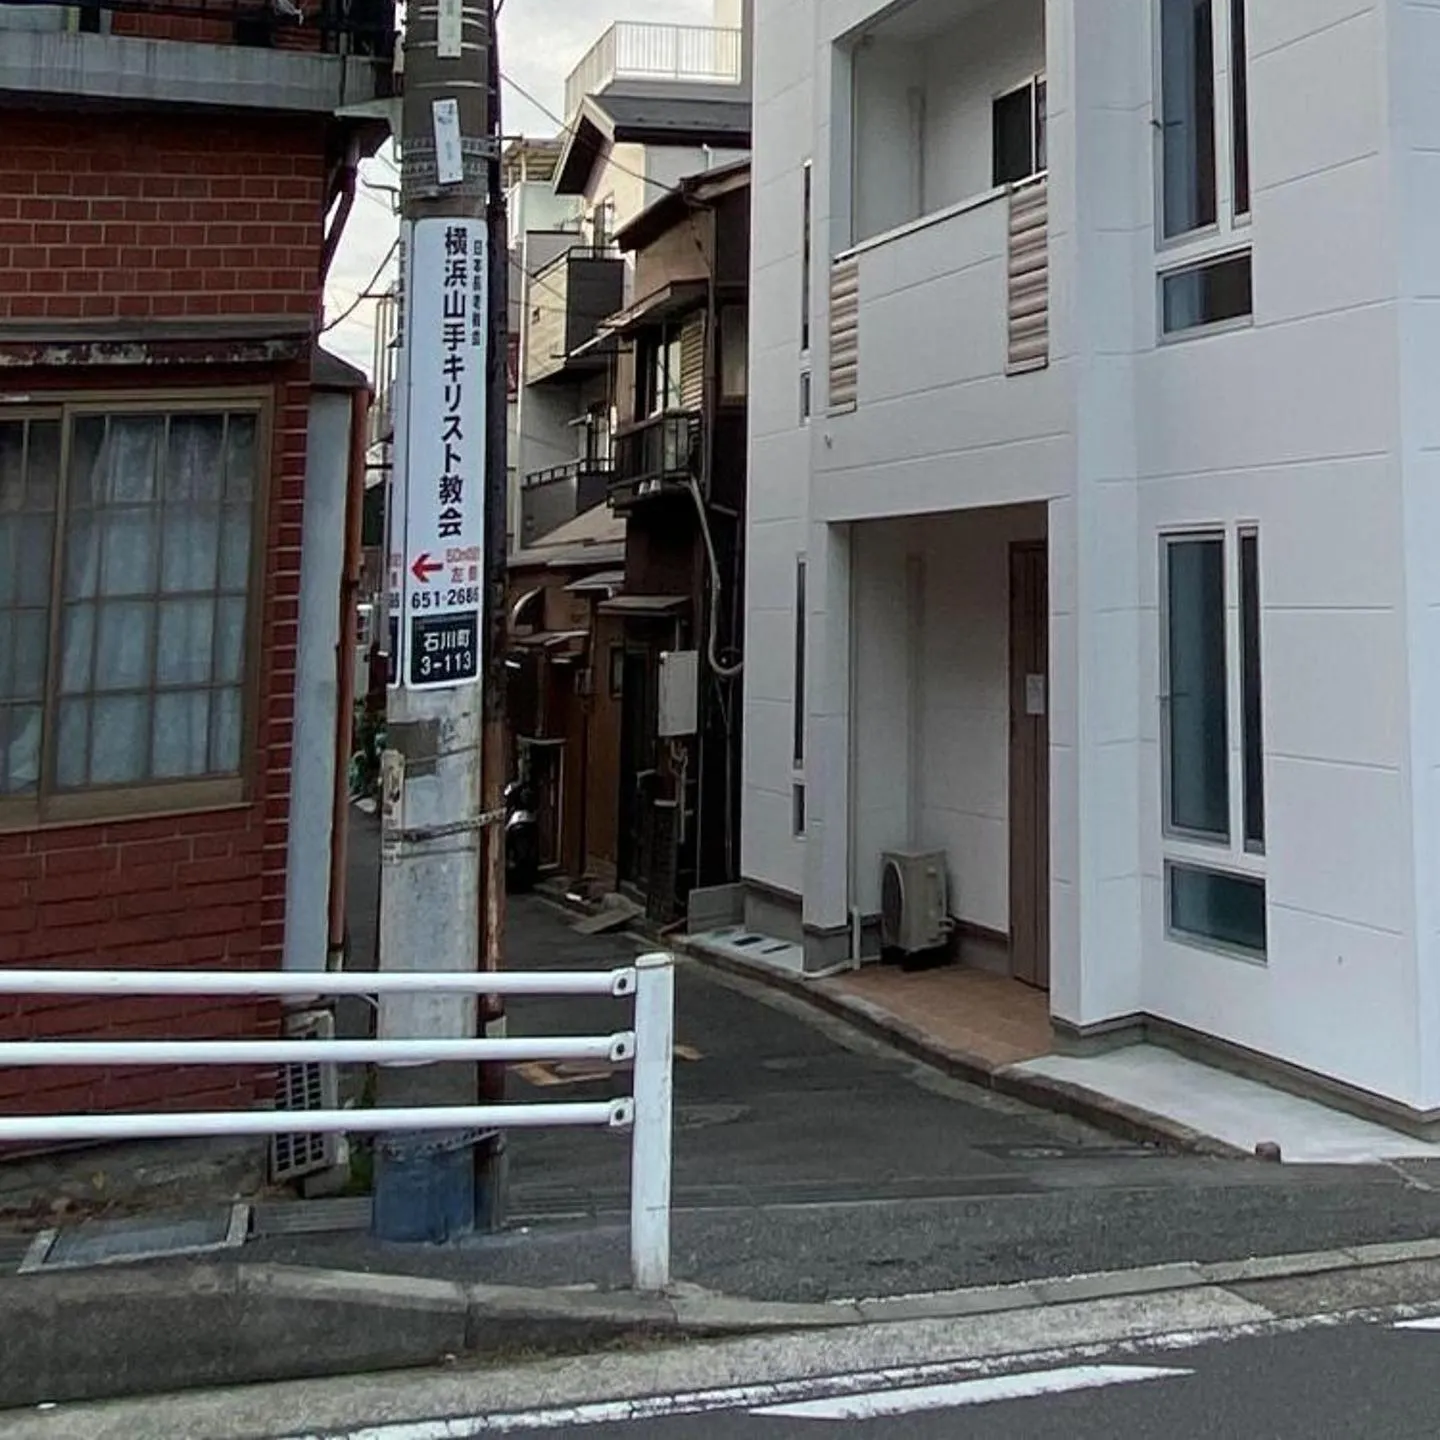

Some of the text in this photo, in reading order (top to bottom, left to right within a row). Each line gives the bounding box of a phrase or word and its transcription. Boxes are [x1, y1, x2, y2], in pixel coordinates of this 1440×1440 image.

[438, 225, 468, 539] 横浜山手キリスト教会
[423, 628, 471, 652] 石川町
[420, 650, 472, 676] 3-113
